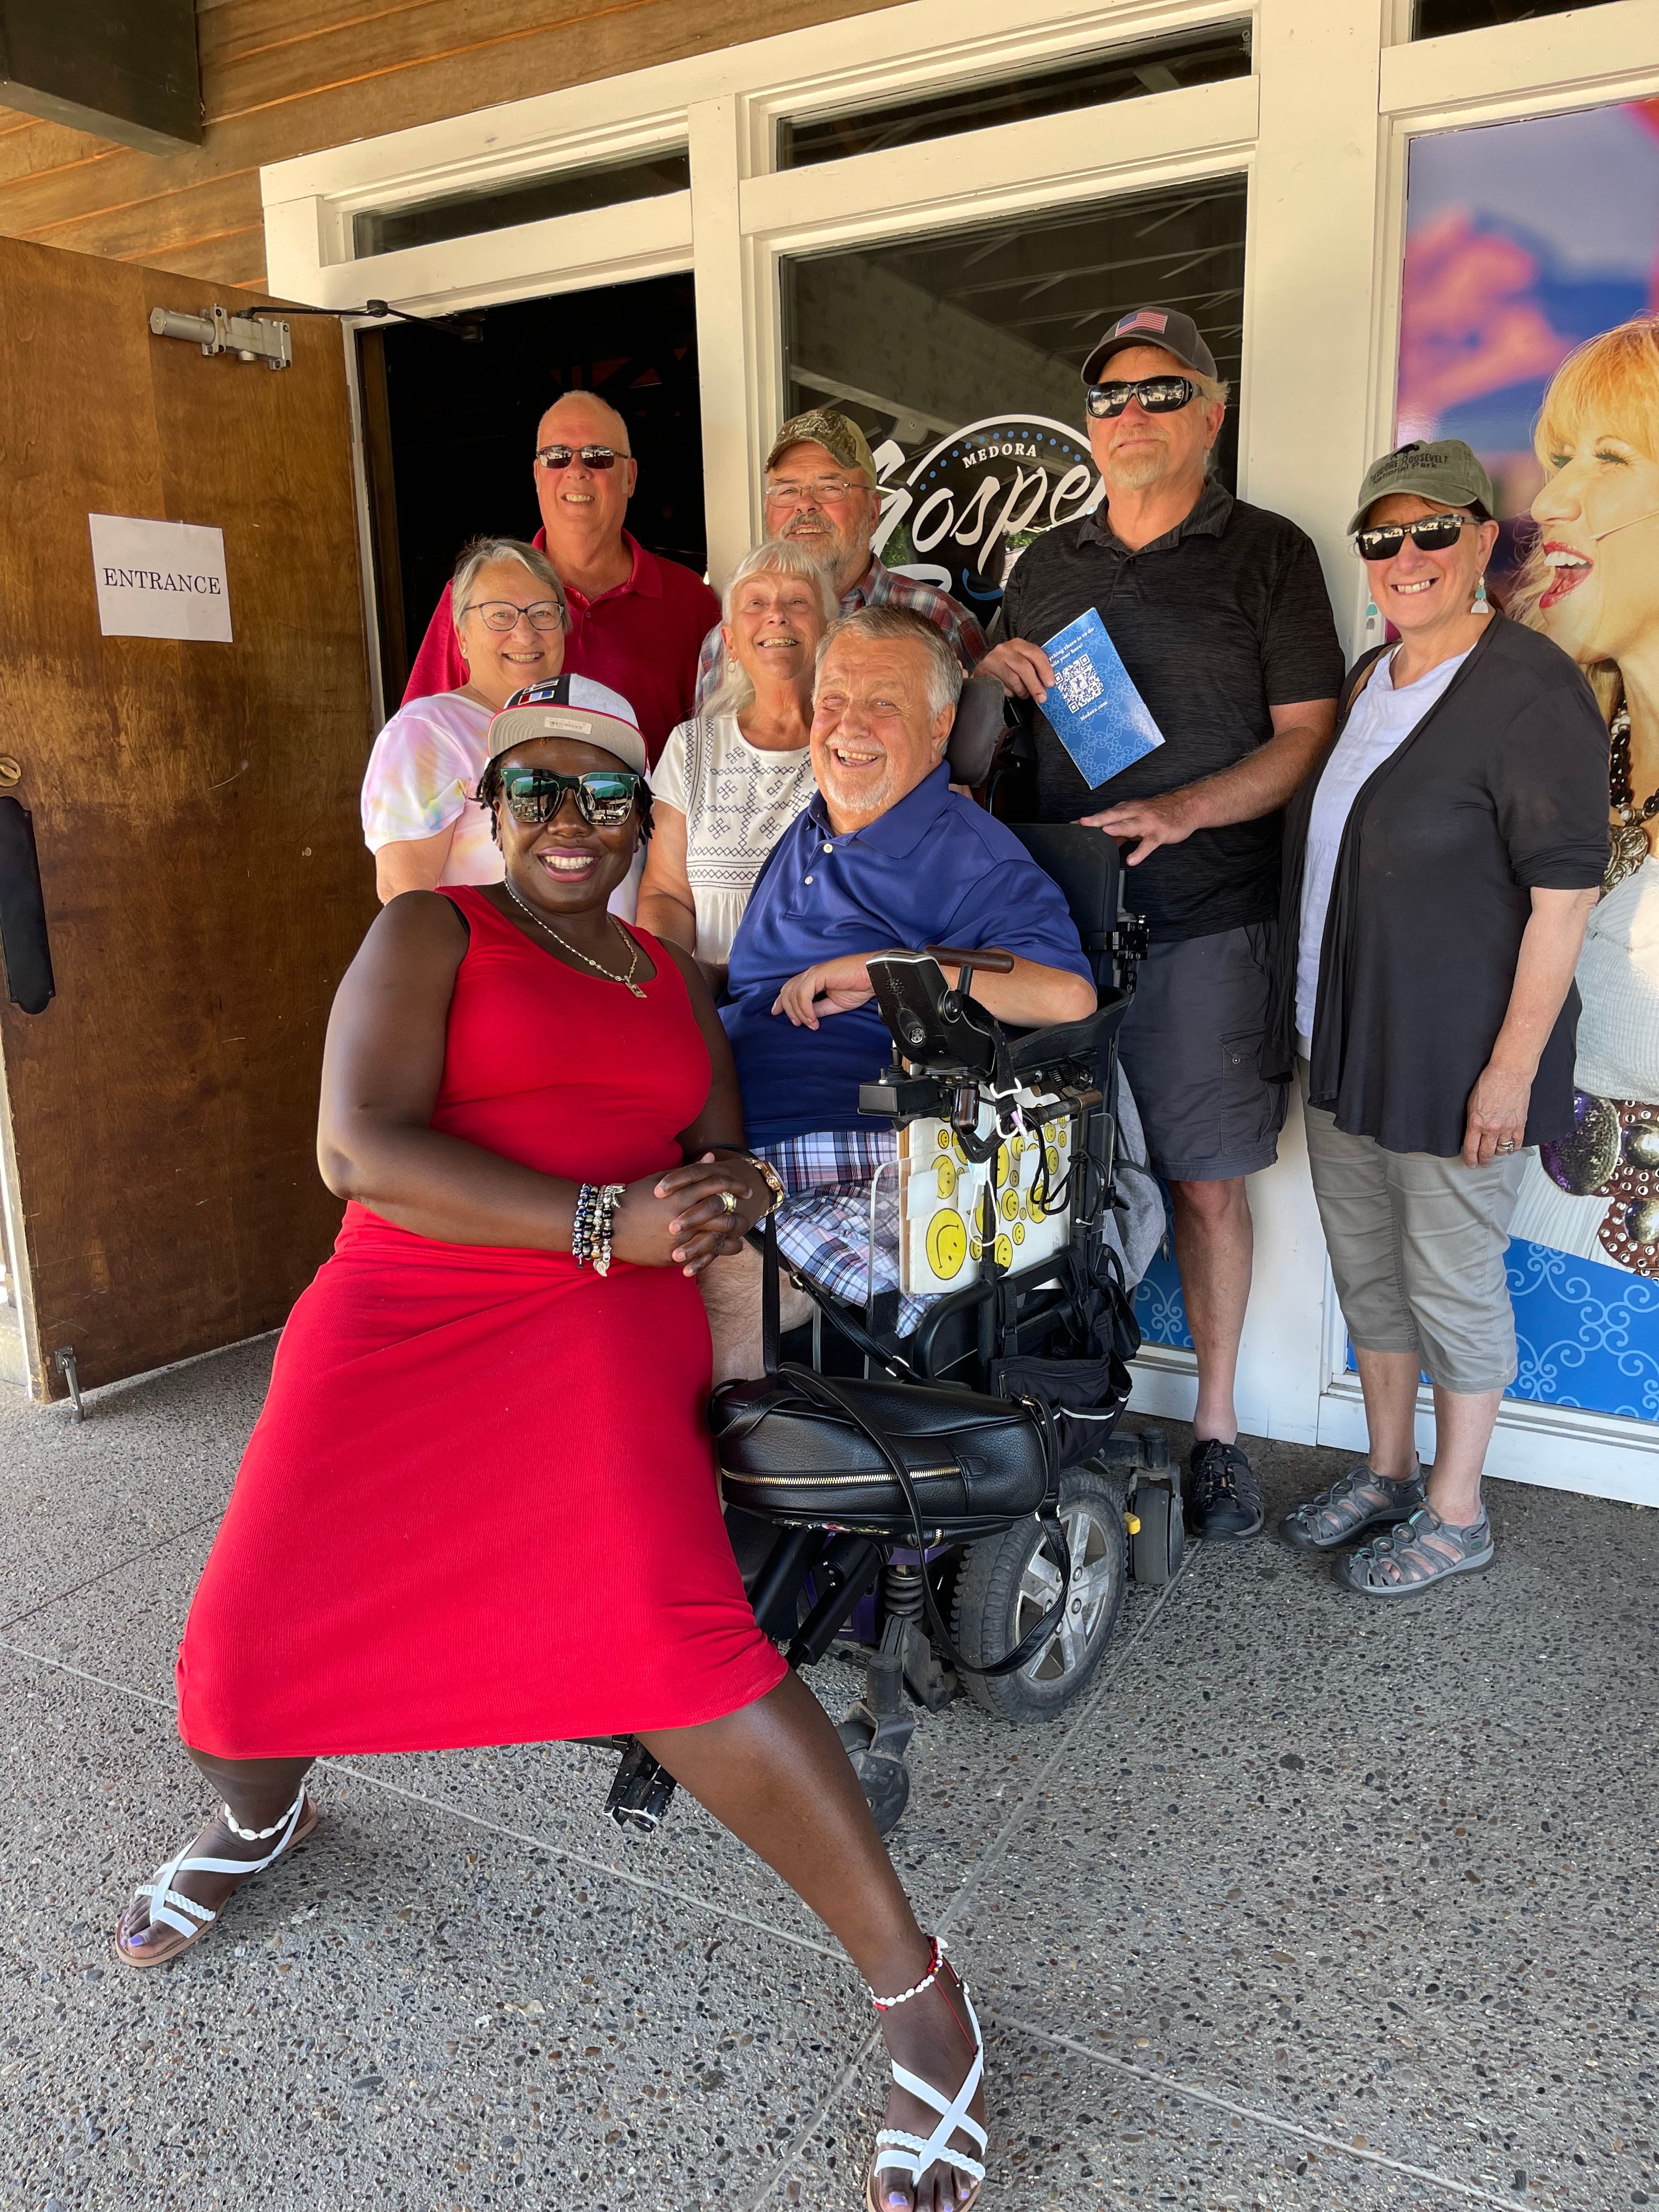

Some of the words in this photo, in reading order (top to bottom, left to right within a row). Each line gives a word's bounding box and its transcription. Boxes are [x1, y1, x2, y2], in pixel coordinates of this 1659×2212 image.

[962, 443, 1037, 469] MEDORA
[1402, 453, 1448, 465] ROOSEVELT
[103, 567, 221, 595] ENTRANCE
[1048, 649, 1064, 662] ything
[1064, 640, 1077, 651] there
[1050, 659, 1060, 668] hile
[1070, 642, 1084, 654] here!
[1080, 701, 1108, 721] Medora.com
